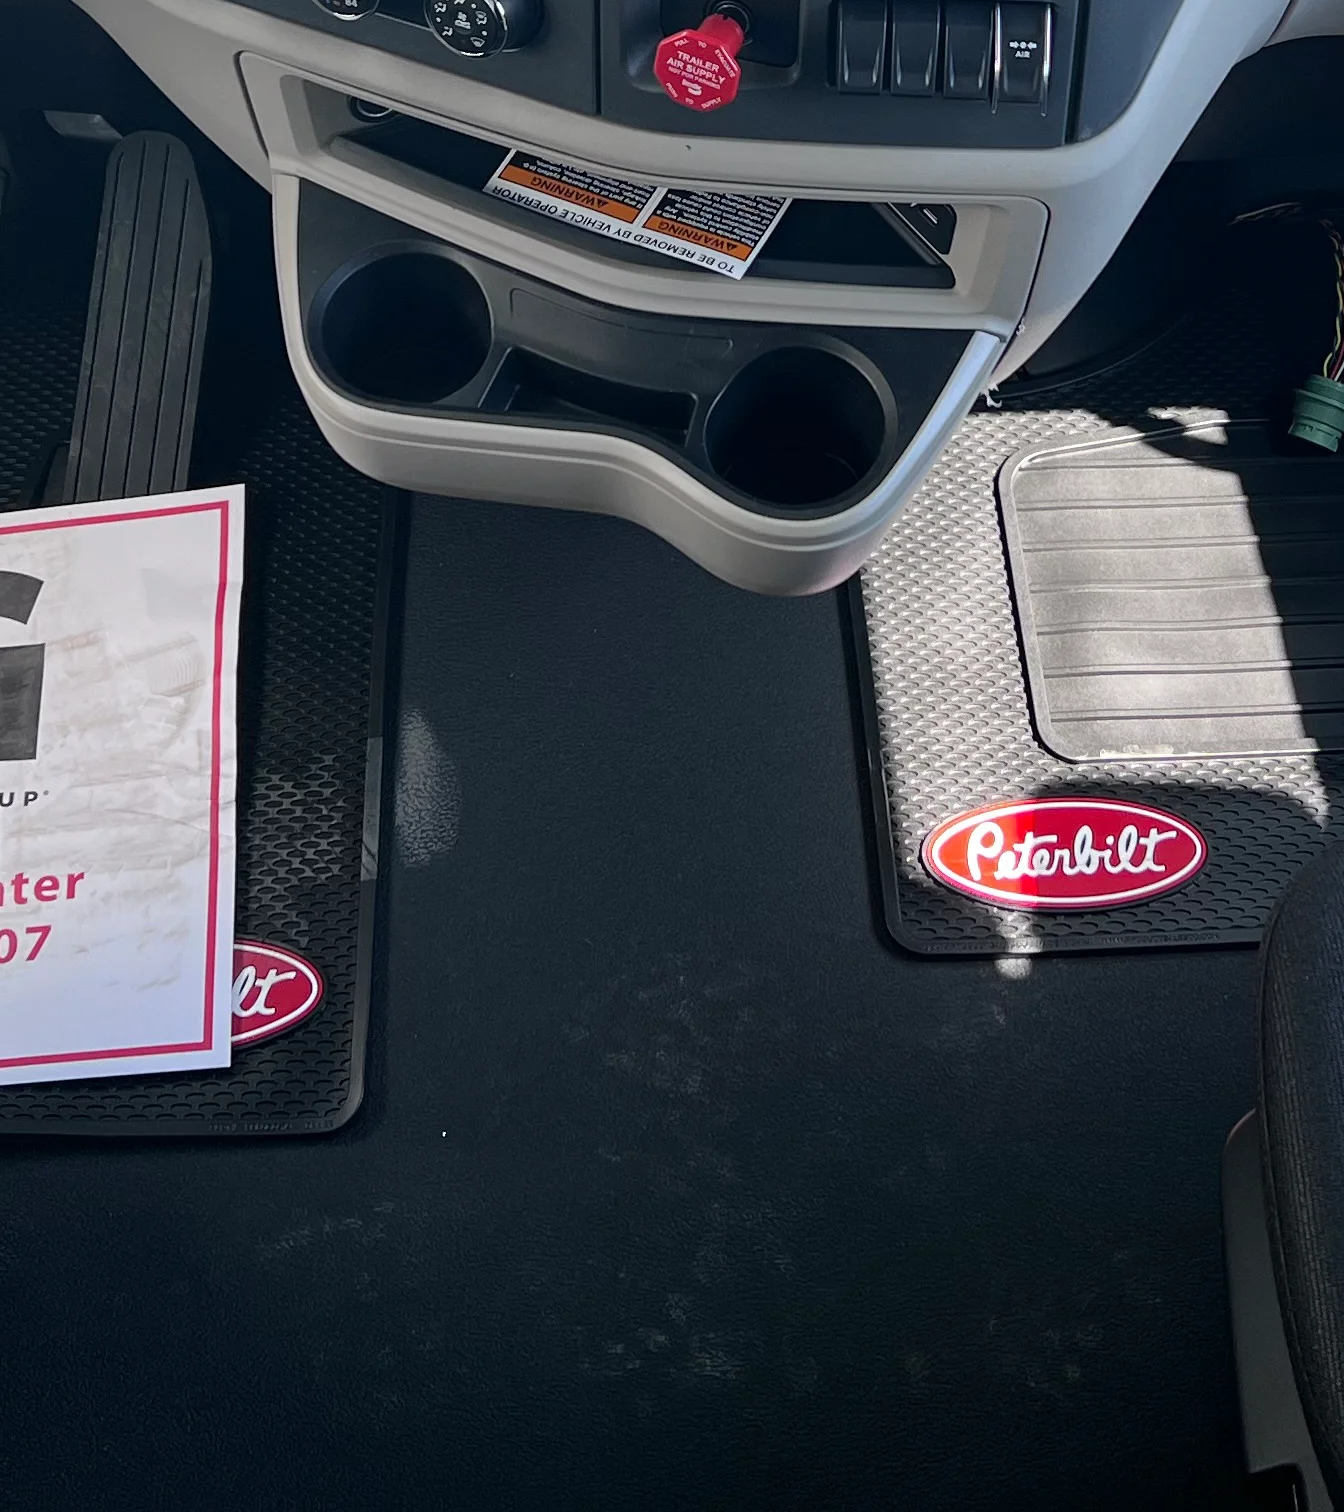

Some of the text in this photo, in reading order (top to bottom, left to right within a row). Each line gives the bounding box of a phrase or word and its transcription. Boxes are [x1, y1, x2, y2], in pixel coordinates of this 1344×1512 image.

[697, 40, 708, 48] TO
[1014, 50, 1031, 59] AIR
[666, 57, 685, 70] AIR
[685, 64, 726, 85] SUPPLY
[677, 50, 720, 73] TRAILER
[681, 69, 694, 80] FOR
[530, 176, 597, 207] WARNING
[492, 185, 735, 274] TO BE REMOVED BY VEHICLE OPERATOR
[658, 221, 726, 250] WARNING
[966, 821, 1178, 882] Peterbilt
